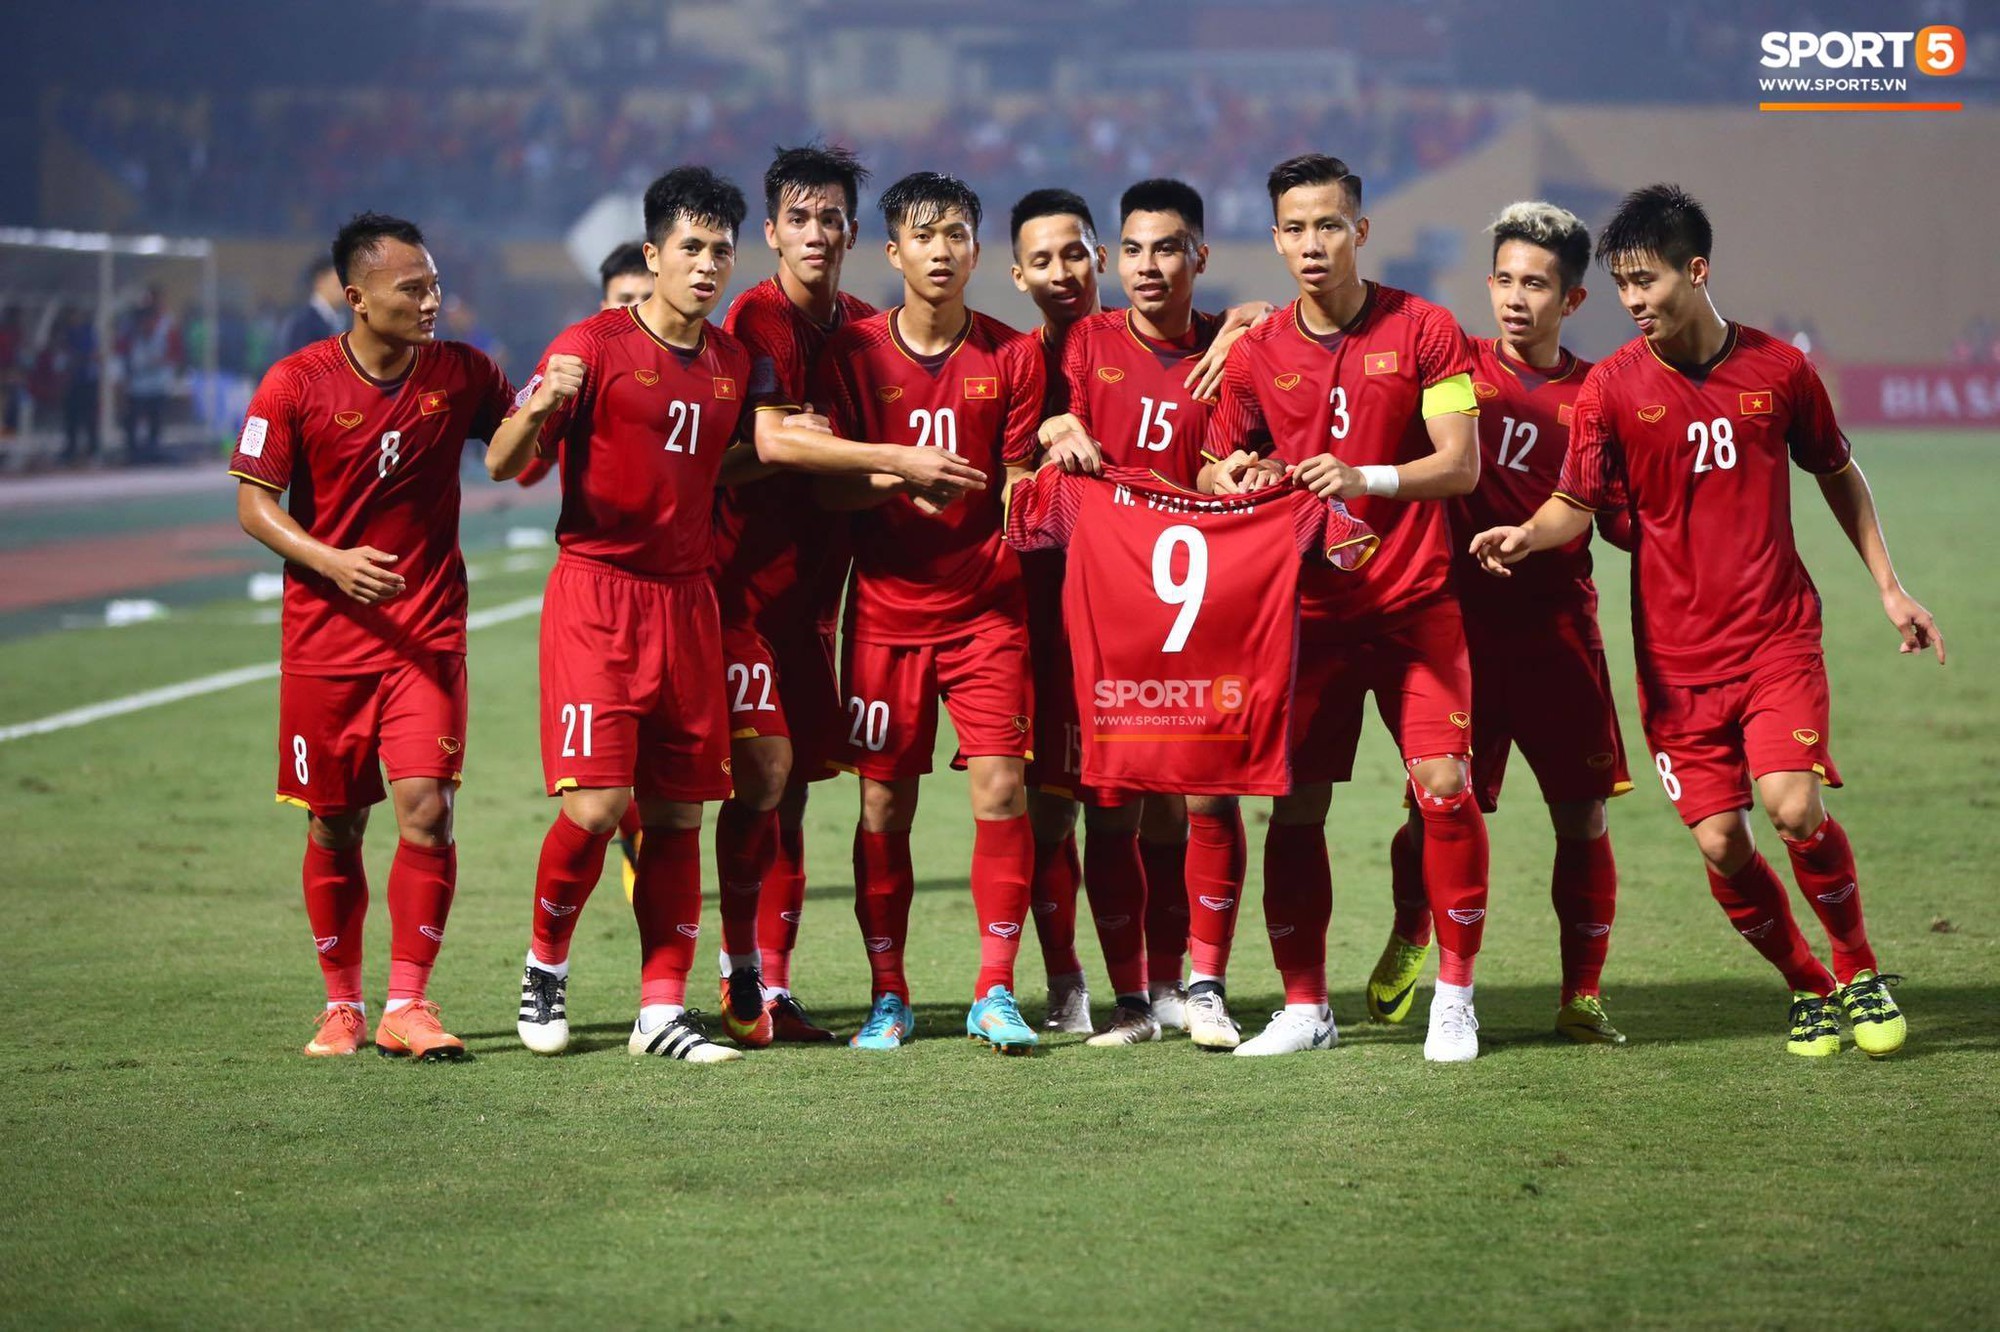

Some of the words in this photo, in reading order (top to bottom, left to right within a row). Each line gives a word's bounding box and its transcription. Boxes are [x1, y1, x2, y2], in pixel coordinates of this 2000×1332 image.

[664, 399, 701, 456] 21
[908, 407, 957, 454] 20
[1136, 396, 1178, 453] 15
[1329, 386, 1351, 440] 3
[378, 430, 401, 479] 8
[1496, 415, 1539, 473] 12
[1686, 417, 1738, 474] 28
[1151, 524, 1209, 653] 9
[726, 662, 776, 712] 22
[561, 703, 593, 758] 21
[848, 696, 890, 751] 20
[293, 734, 309, 786] 8
